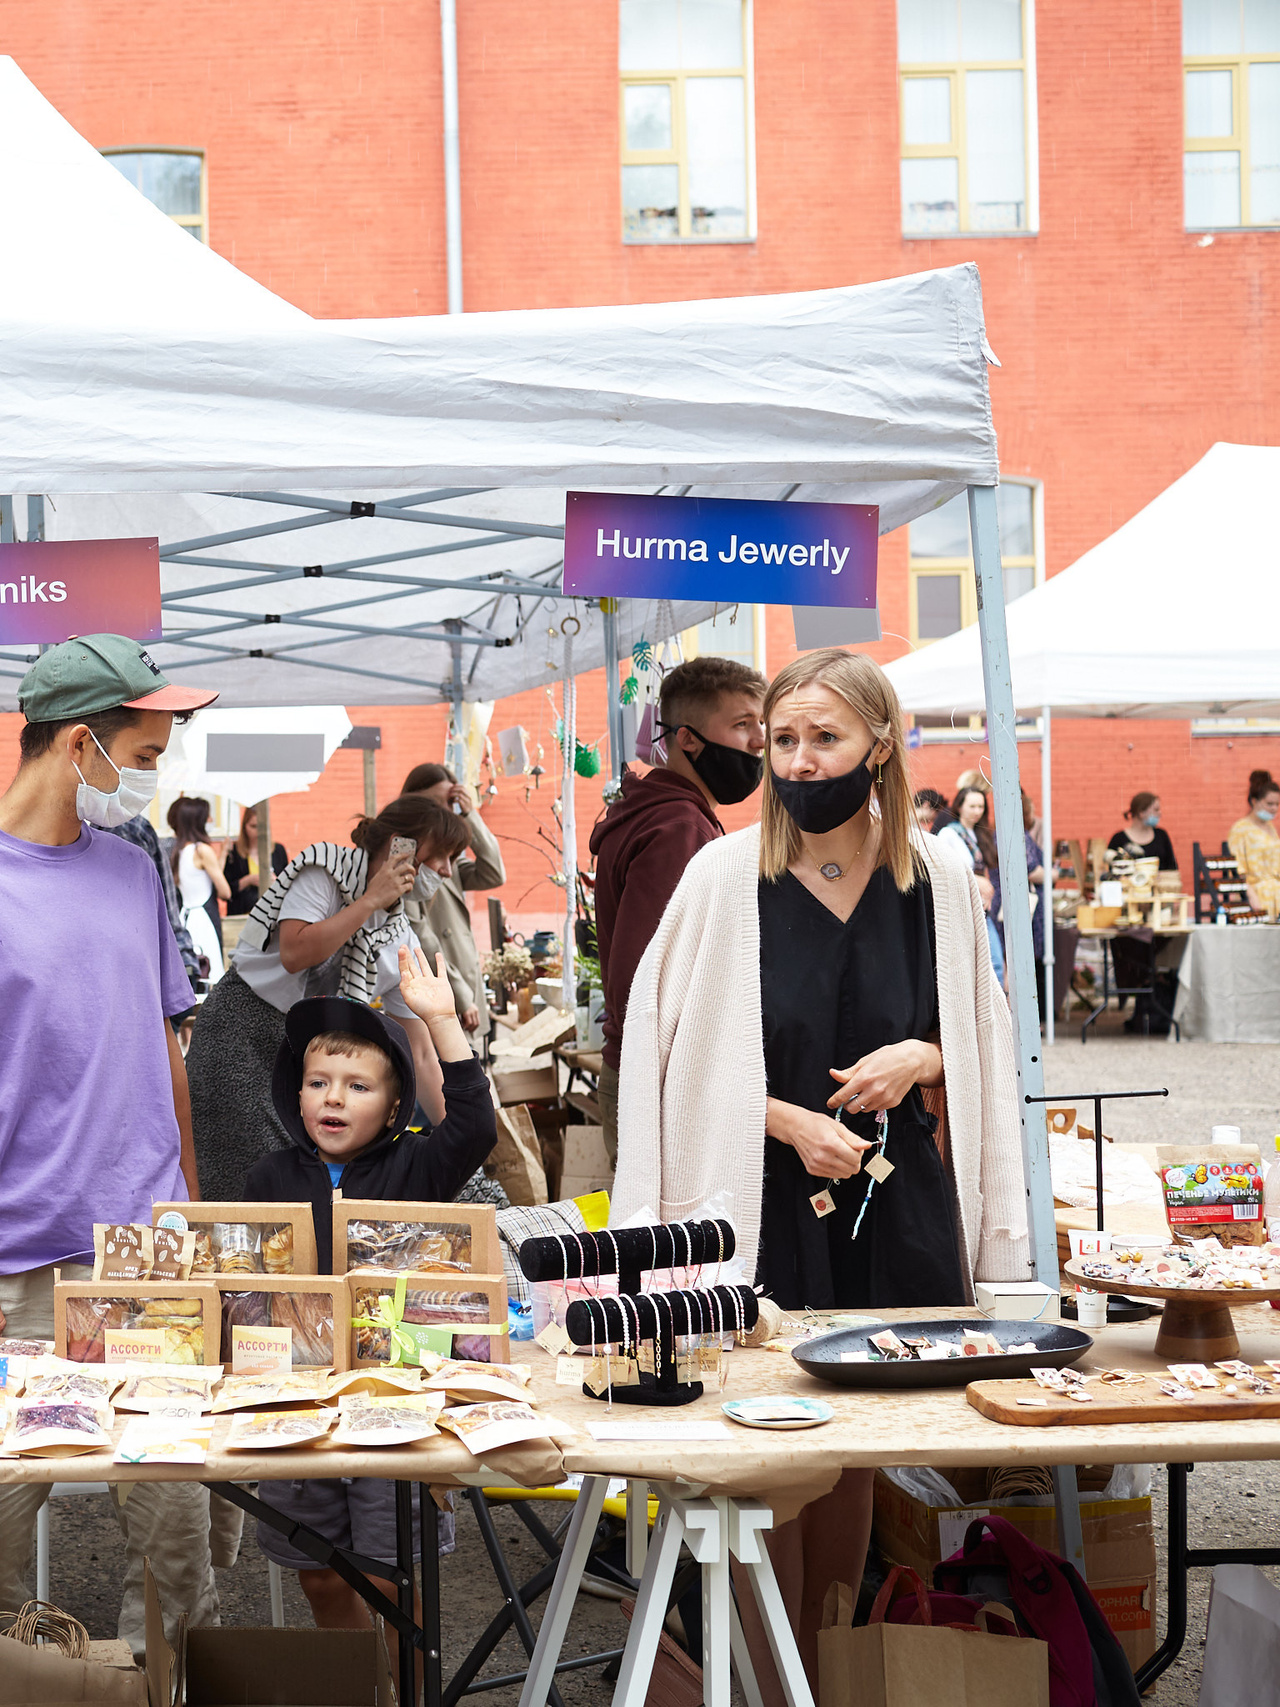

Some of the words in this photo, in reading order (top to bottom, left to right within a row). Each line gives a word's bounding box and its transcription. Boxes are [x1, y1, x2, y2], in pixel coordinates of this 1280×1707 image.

[596, 528, 709, 561] Hurma
[718, 534, 851, 574] Jewerly
[1166, 1189, 1210, 1199] ПЕЧЕНЬЕ
[1211, 1188, 1260, 1198] МУЛЬТИКИ
[110, 1344, 161, 1354] АССОРТИ
[237, 1340, 288, 1352] АССОРТИ
[1098, 1595, 1140, 1609] OPHAR
